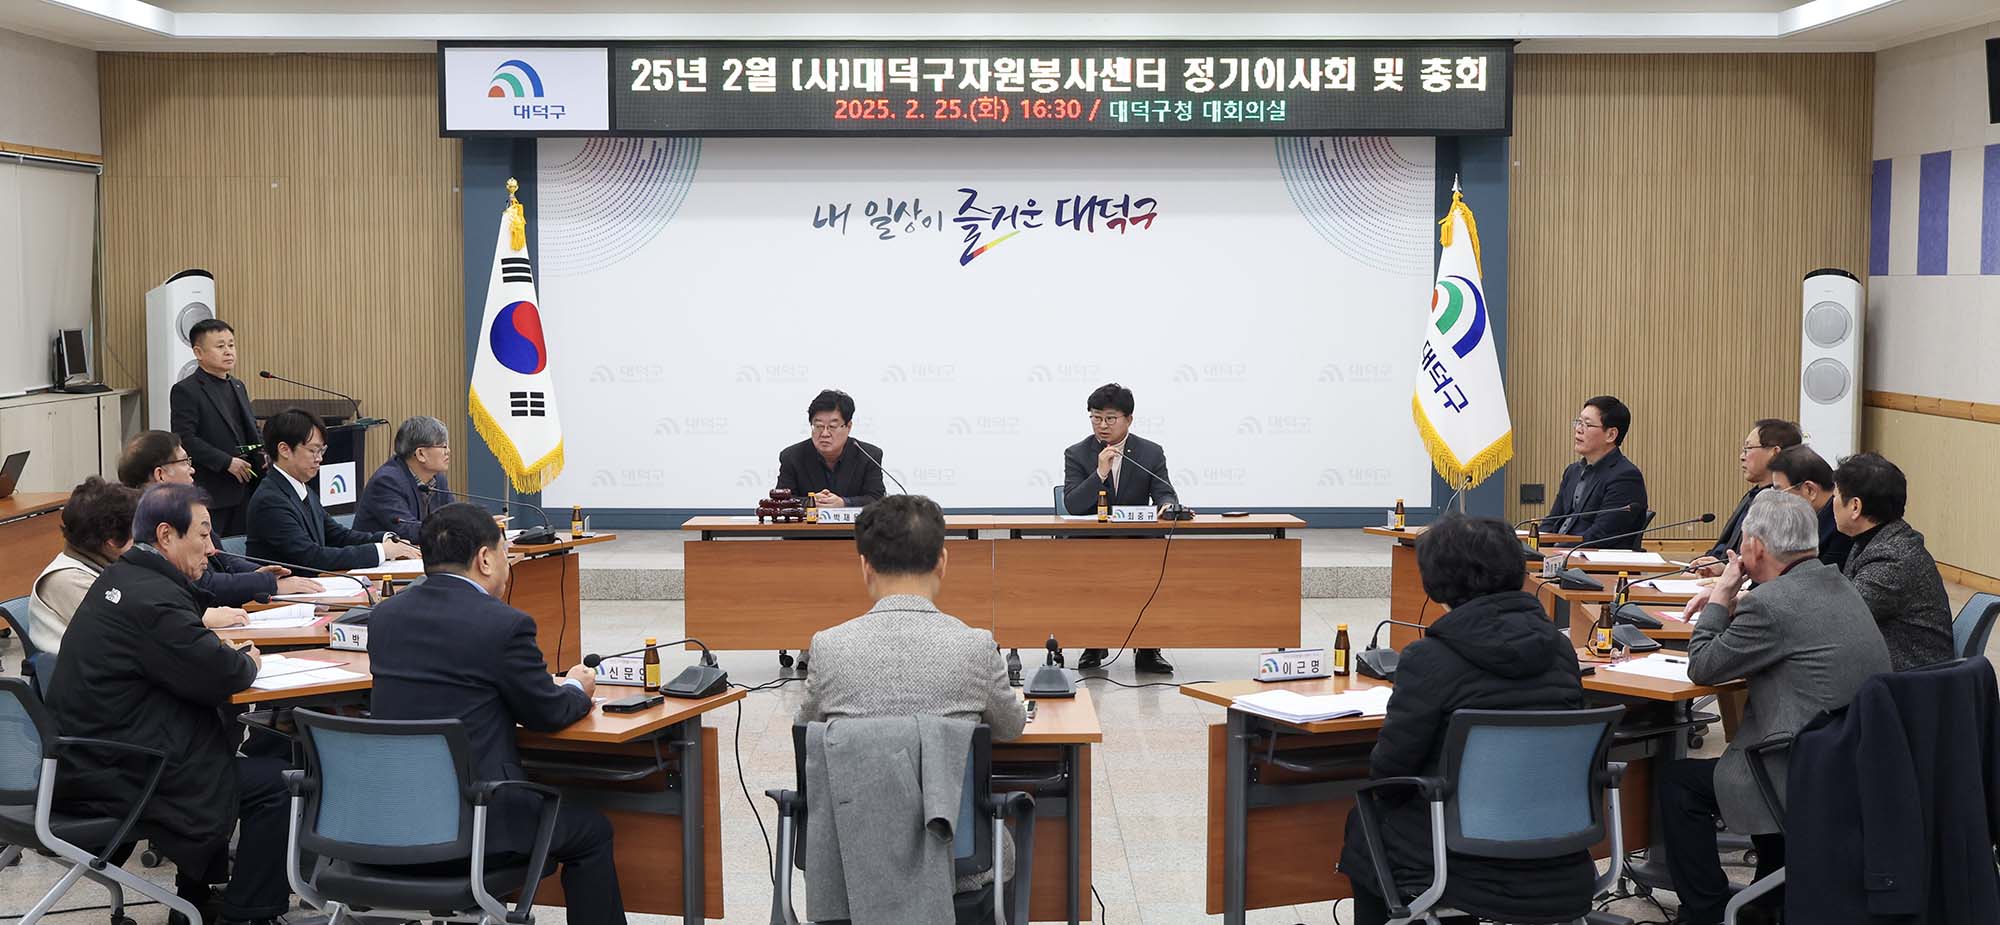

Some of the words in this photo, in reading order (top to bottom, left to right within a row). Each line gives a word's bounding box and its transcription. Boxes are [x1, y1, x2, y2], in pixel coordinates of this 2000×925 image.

[631, 57, 707, 93] 25년
[722, 57, 777, 93] 2월
[1183, 56, 1356, 93] 정기이사회
[1373, 57, 1404, 92] 및
[1420, 56, 1487, 93] 총회
[513, 104, 566, 120] 대덕구
[834, 99, 896, 120] 2025.
[905, 98, 925, 119] 2.
[934, 95, 1010, 122] 25.(화)
[1020, 98, 1082, 119] 16:30
[1088, 97, 1101, 122] /
[1109, 99, 1193, 123] 대덕구청
[1202, 99, 1287, 123] 대회의실
[812, 202, 852, 235] 내
[864, 197, 943, 241] 일상이
[952, 187, 1044, 267] 즐거운
[1054, 193, 1158, 235] 대덕구
[1422, 340, 1469, 413] 대덕구
